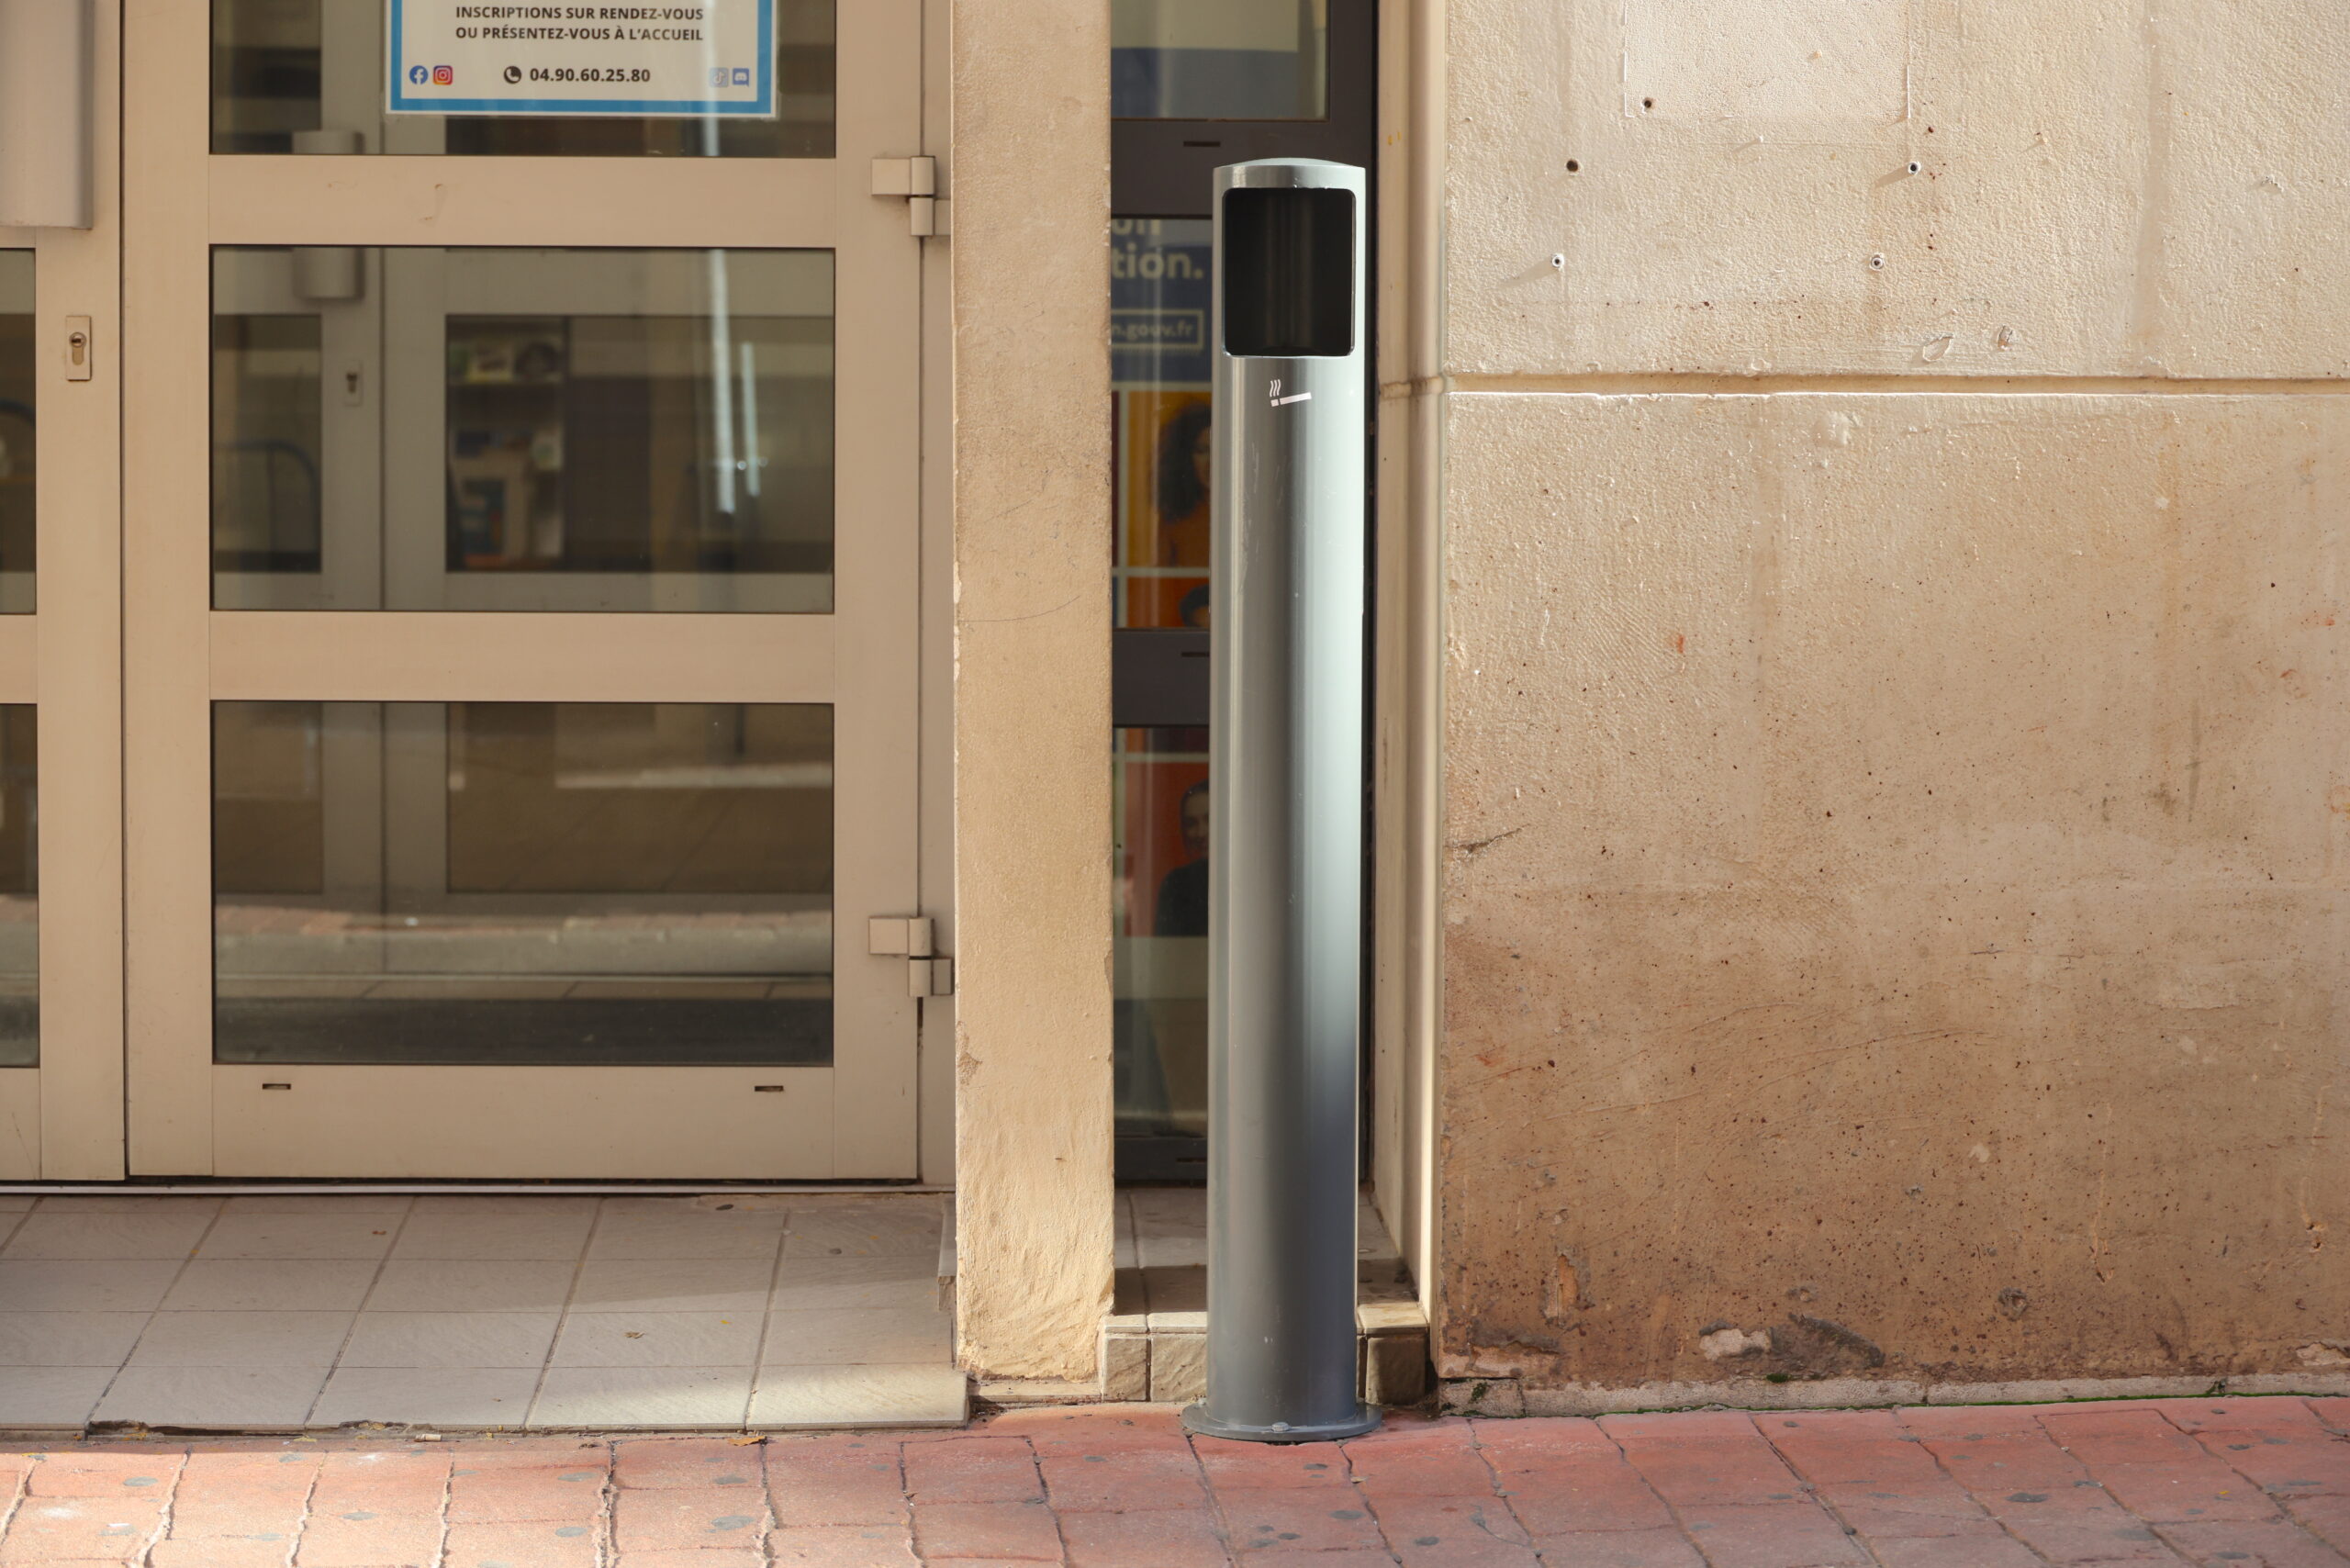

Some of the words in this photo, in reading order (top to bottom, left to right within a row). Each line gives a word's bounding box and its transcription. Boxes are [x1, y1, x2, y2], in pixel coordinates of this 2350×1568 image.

[455, 6, 562, 19] INSCRIPTIONS
[565, 6, 596, 20] SUR
[599, 6, 704, 21] RENDEZ-VOUS
[455, 27, 478, 39] OU
[482, 24, 610, 40] PRÉSENTEZ-VOUS
[613, 25, 625, 40] À
[529, 67, 651, 83] 04.90.60.25.80
